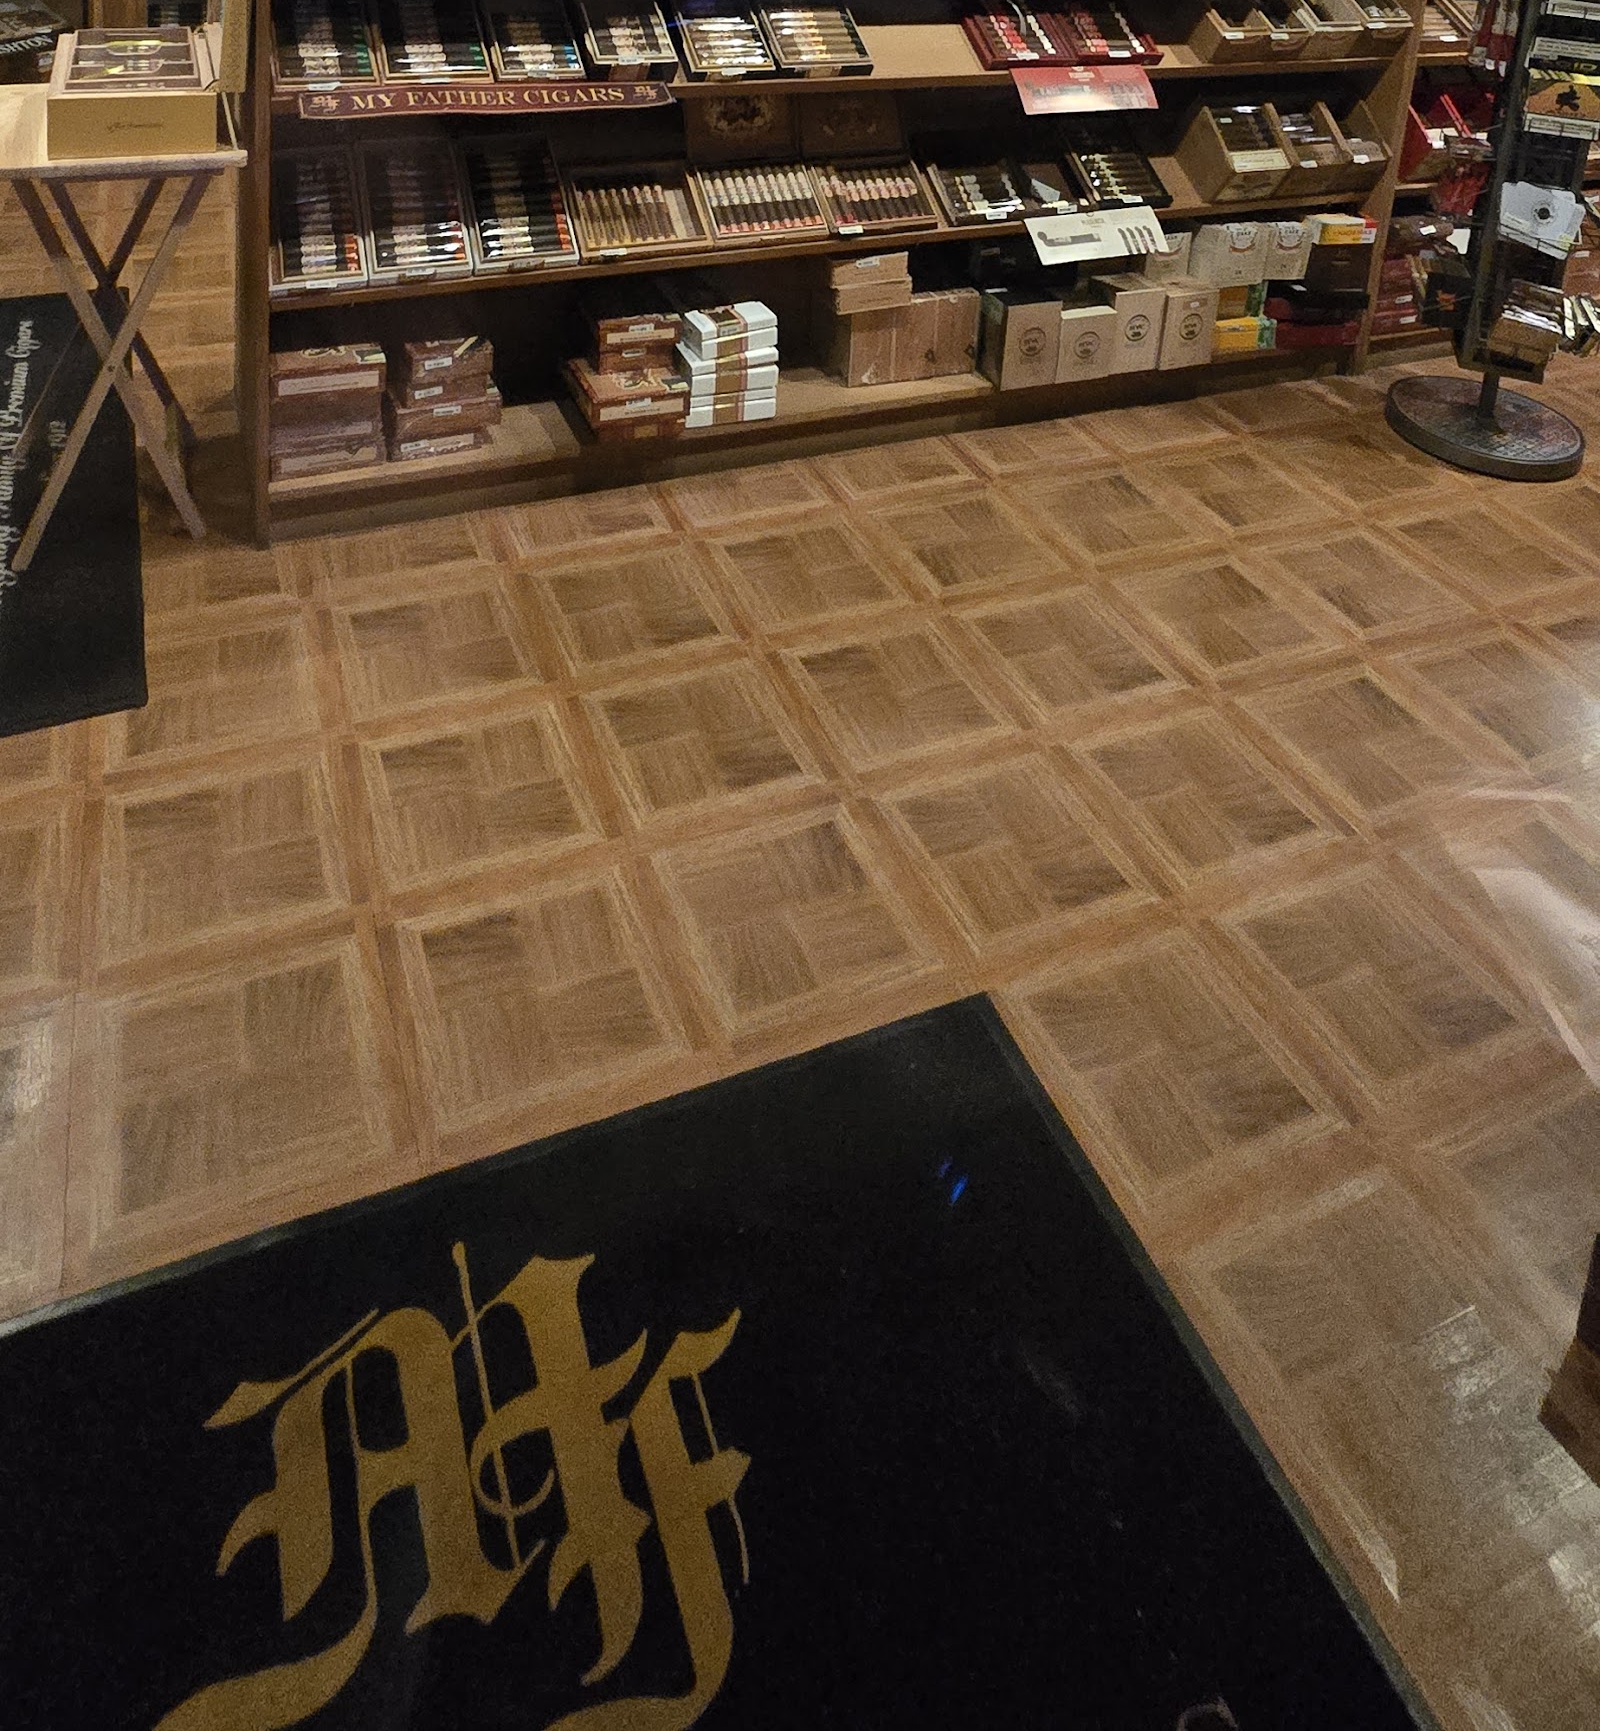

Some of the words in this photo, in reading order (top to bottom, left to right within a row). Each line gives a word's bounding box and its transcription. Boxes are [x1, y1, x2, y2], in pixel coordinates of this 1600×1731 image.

[352, 92, 396, 110] MY
[407, 90, 516, 107] FATHER
[523, 88, 625, 105] CIGARS
